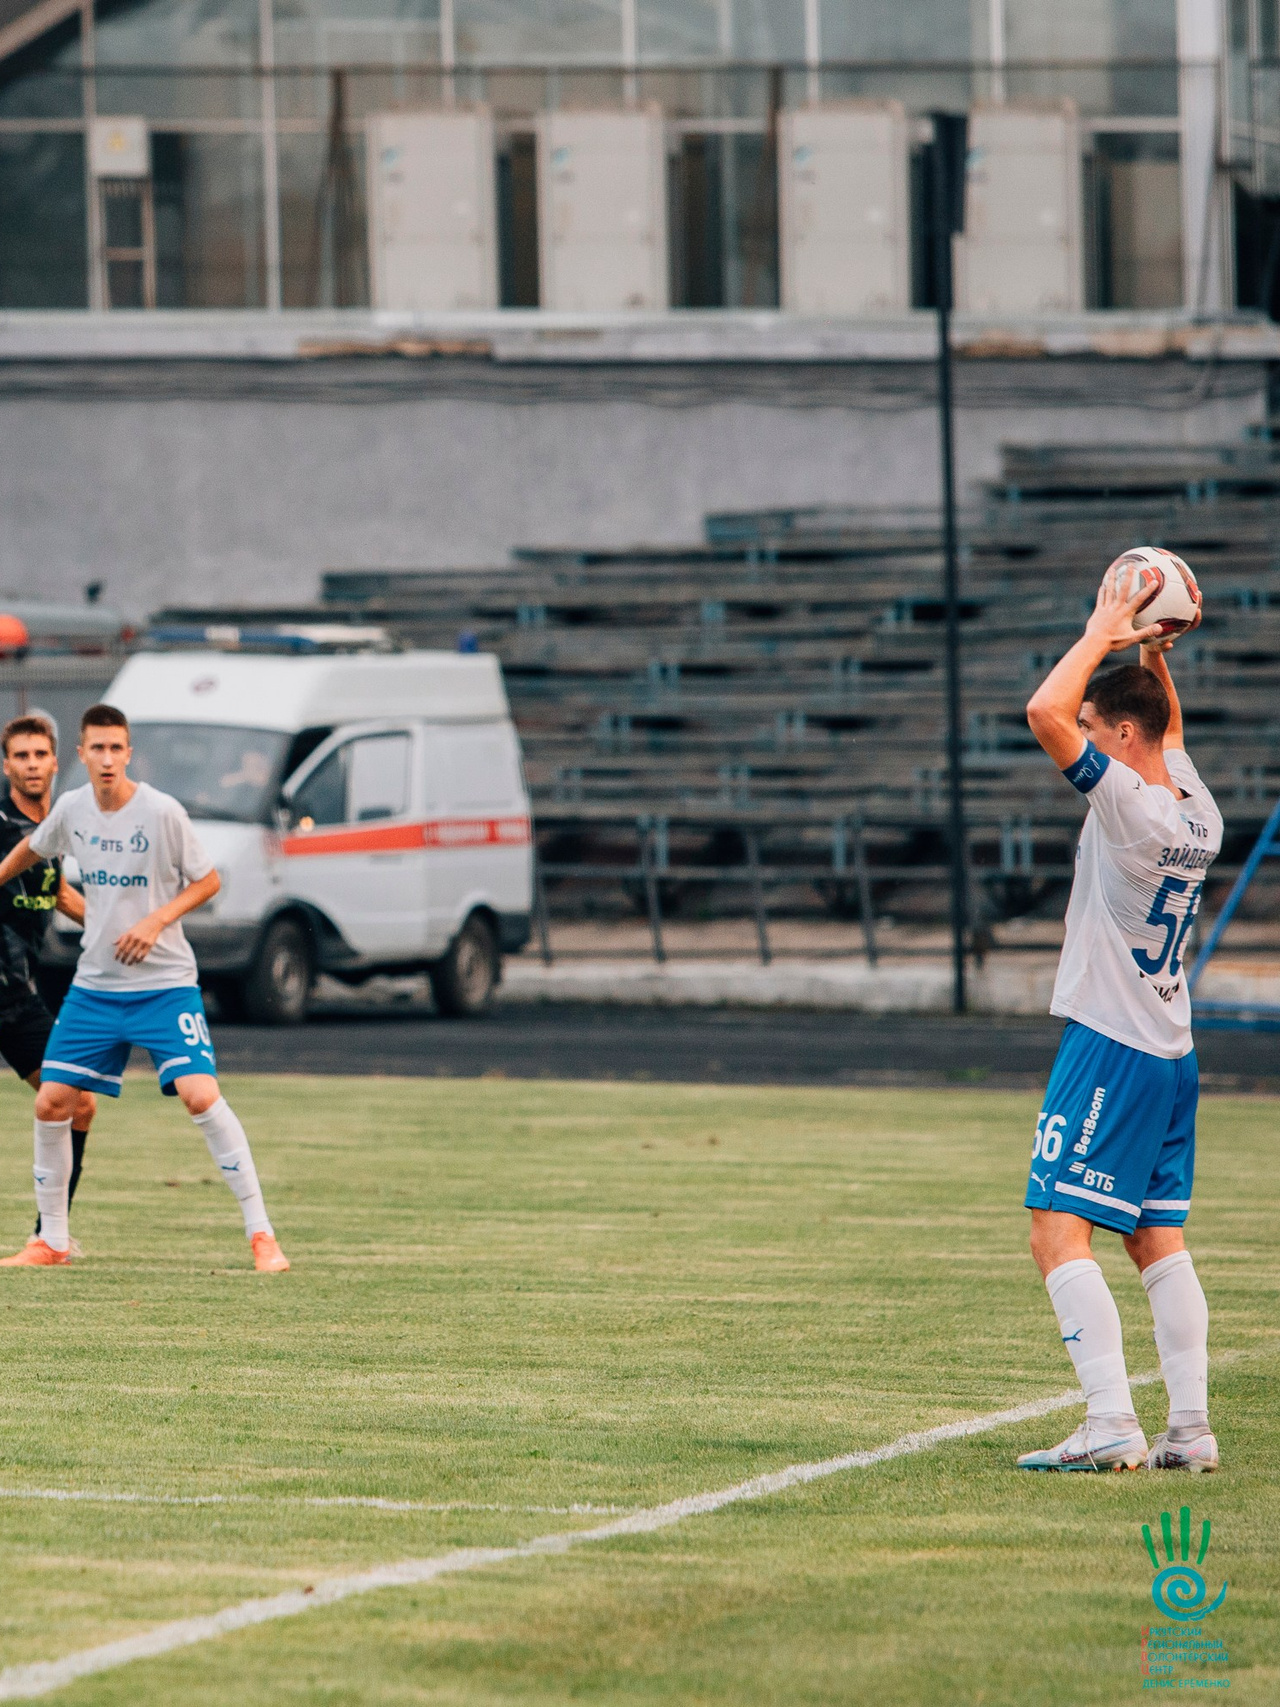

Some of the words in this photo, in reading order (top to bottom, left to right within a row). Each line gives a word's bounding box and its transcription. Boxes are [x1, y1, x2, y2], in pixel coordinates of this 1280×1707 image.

[101, 839, 124, 853] ВТБ
[80, 868, 148, 888] tBoom
[178, 1012, 211, 1046] 90
[1073, 1087, 1106, 1156] BetBoom
[1082, 1168, 1115, 1193] ВТБ
